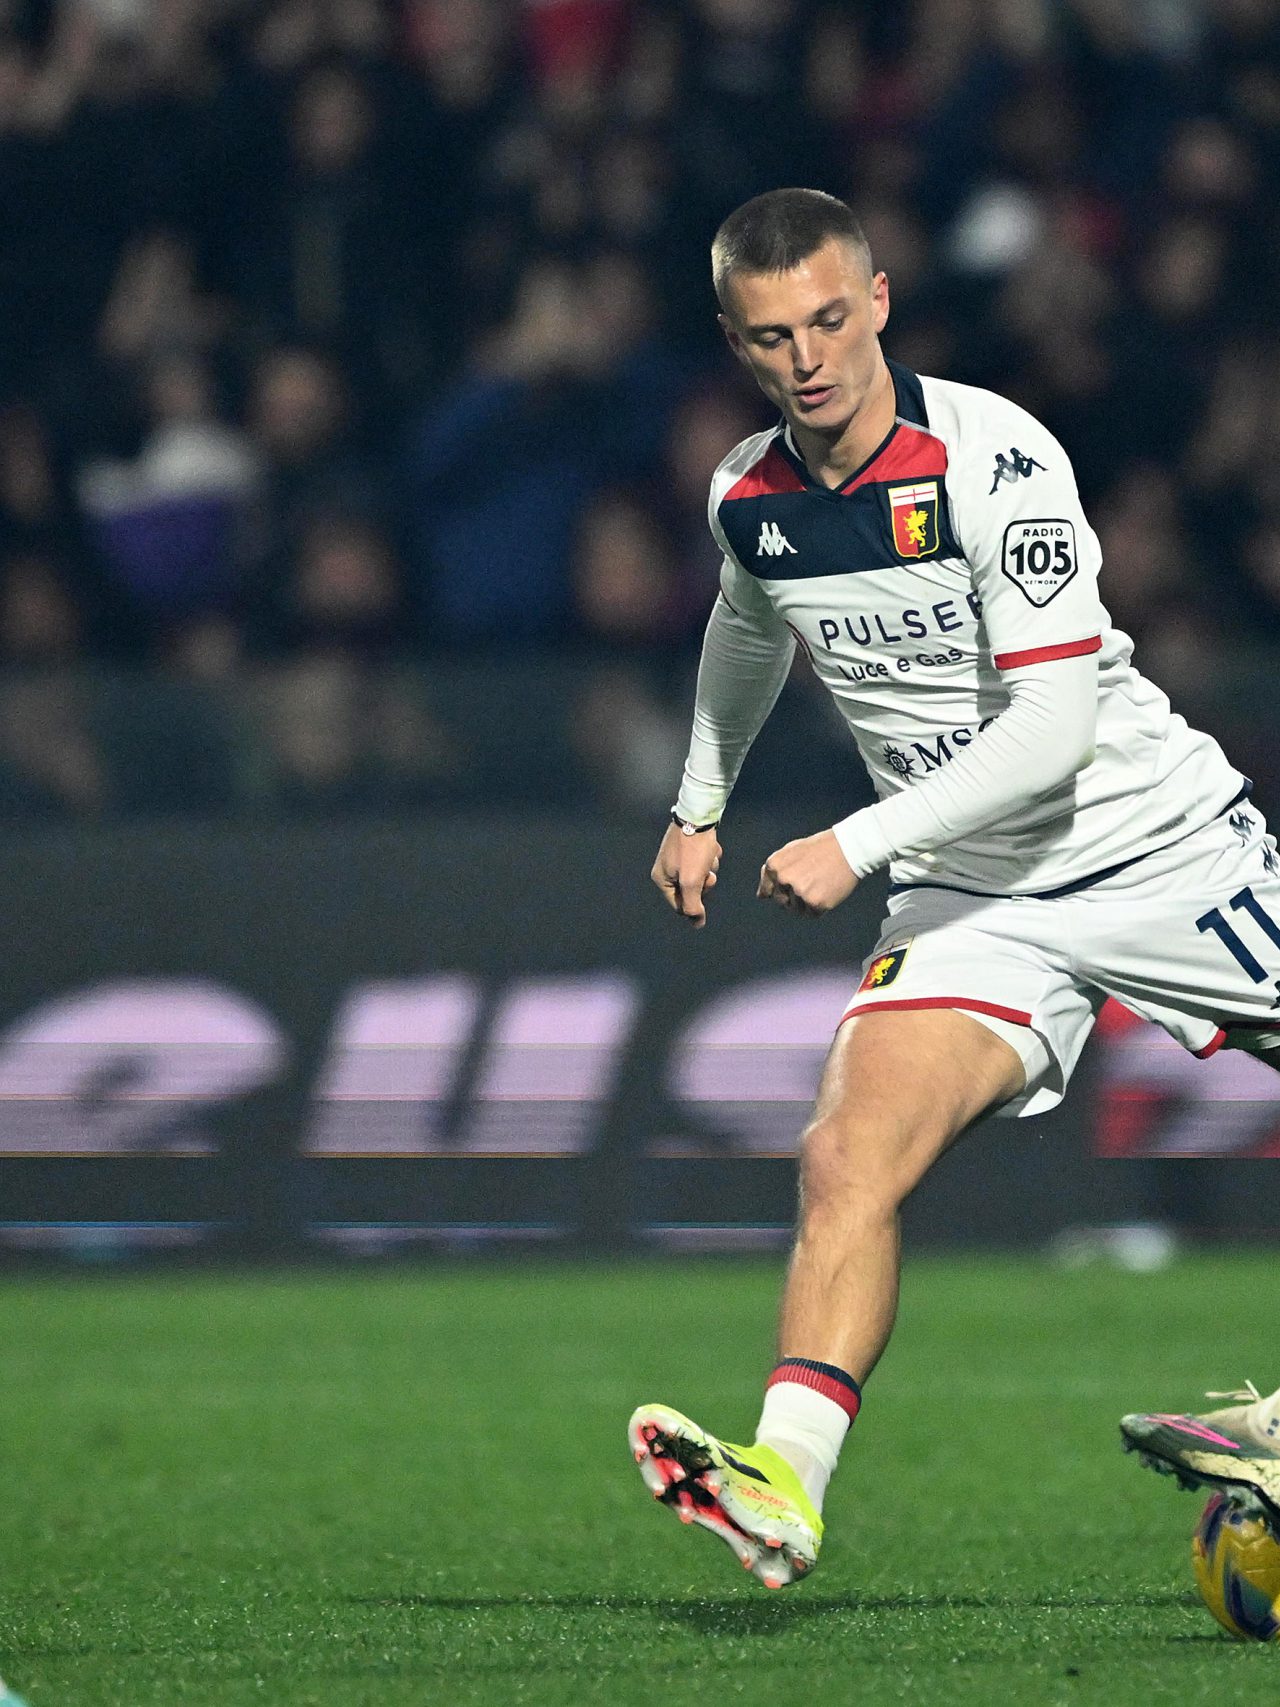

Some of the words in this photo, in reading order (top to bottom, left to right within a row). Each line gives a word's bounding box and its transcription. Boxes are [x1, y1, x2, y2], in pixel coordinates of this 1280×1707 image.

[1022, 527, 1064, 538] RADIO
[1009, 540, 1072, 576] 105
[838, 661, 889, 681] Luce
[896, 656, 912, 673] e
[915, 648, 964, 667] Gas
